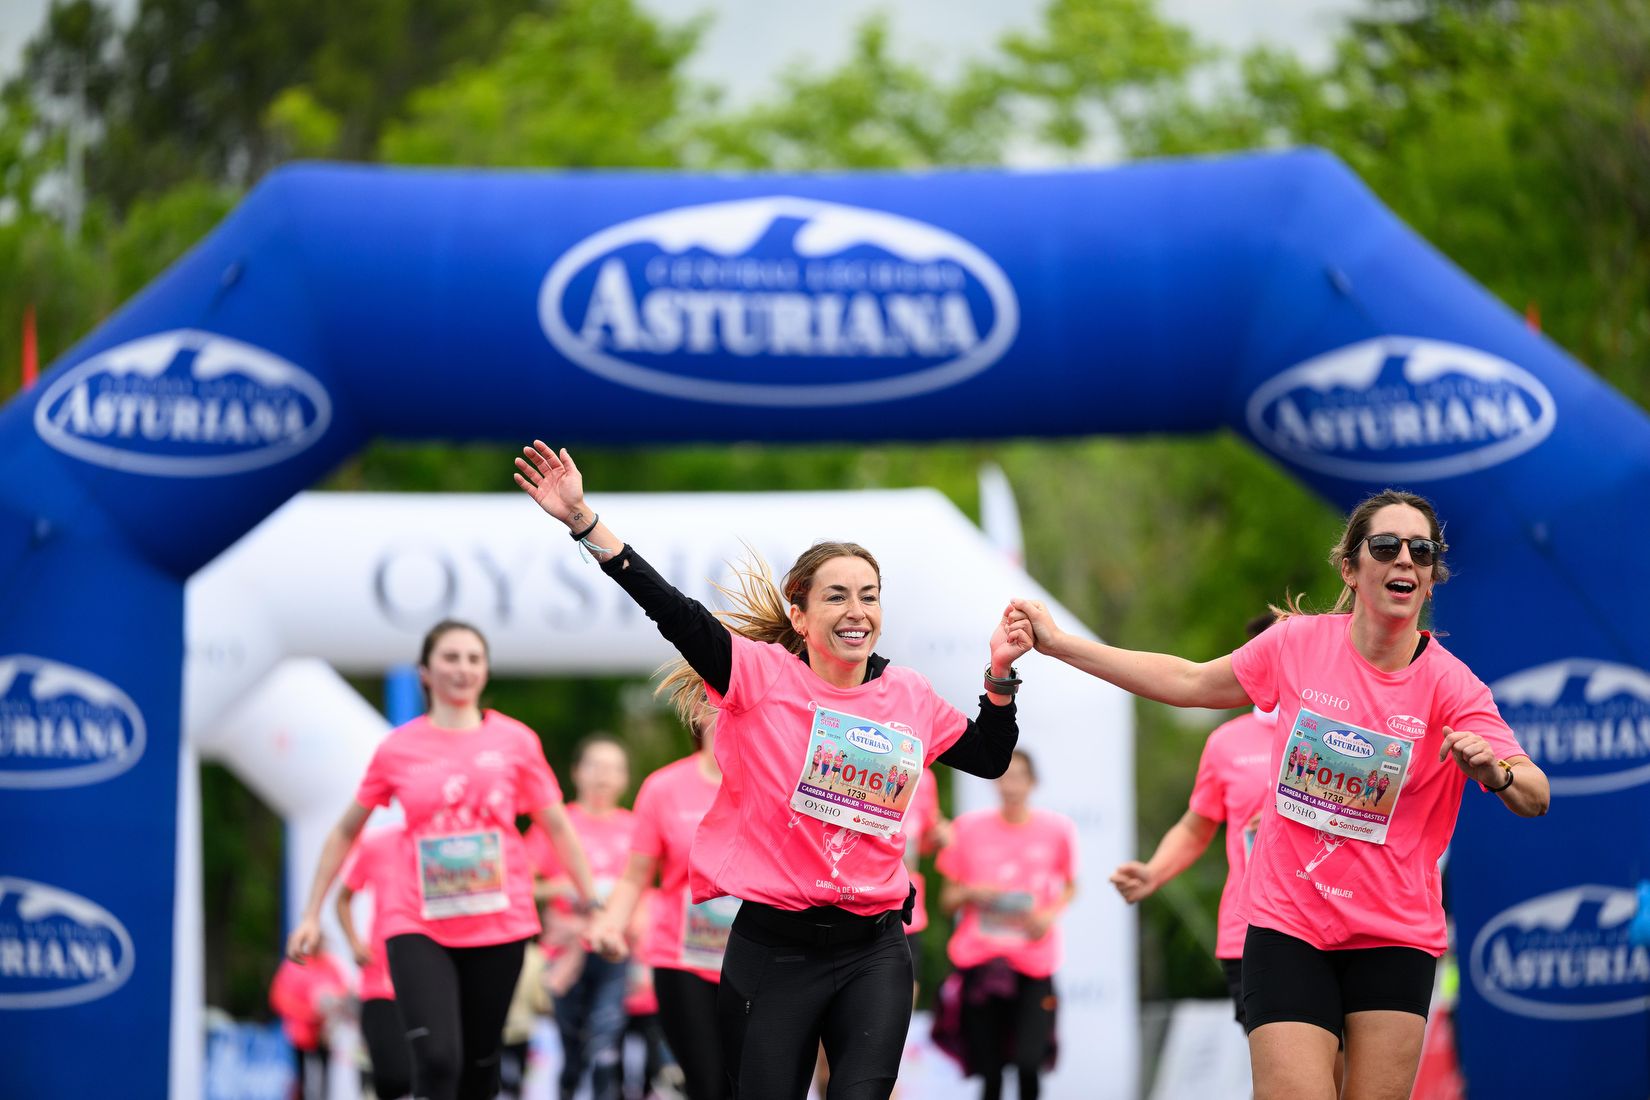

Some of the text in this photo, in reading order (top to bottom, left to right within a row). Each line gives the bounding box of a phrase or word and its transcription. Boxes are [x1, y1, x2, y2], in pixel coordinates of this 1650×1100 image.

[579, 258, 983, 358] ASTURIANA
[54, 379, 305, 445] ASTURIANA
[1273, 391, 1535, 452] ASTURIANA
[1302, 688, 1350, 711] OYSHO
[1390, 718, 1425, 735] ASTURIANA
[849, 731, 890, 752] ASTURIANA
[1325, 734, 1371, 756] ASTURIANA
[841, 764, 884, 790] 016
[1316, 767, 1363, 794] 016
[801, 785, 826, 798] CARRERA
[826, 792, 834, 800] DE
[834, 794, 841, 802] LA
[841, 797, 860, 808] MUJER
[847, 788, 867, 801] 1739
[1280, 786, 1386, 822] CARRERA DE LA MUJER VITORIA-GASTEIZ
[1322, 791, 1344, 804] 1738
[804, 799, 841, 817] OYSHO
[1284, 801, 1317, 820] OYSHO
[861, 817, 890, 831] Santander
[1338, 821, 1373, 834] Santander
[842, 886, 851, 894] DE
[1315, 881, 1324, 891] DE
[1331, 887, 1354, 899] MUJER
